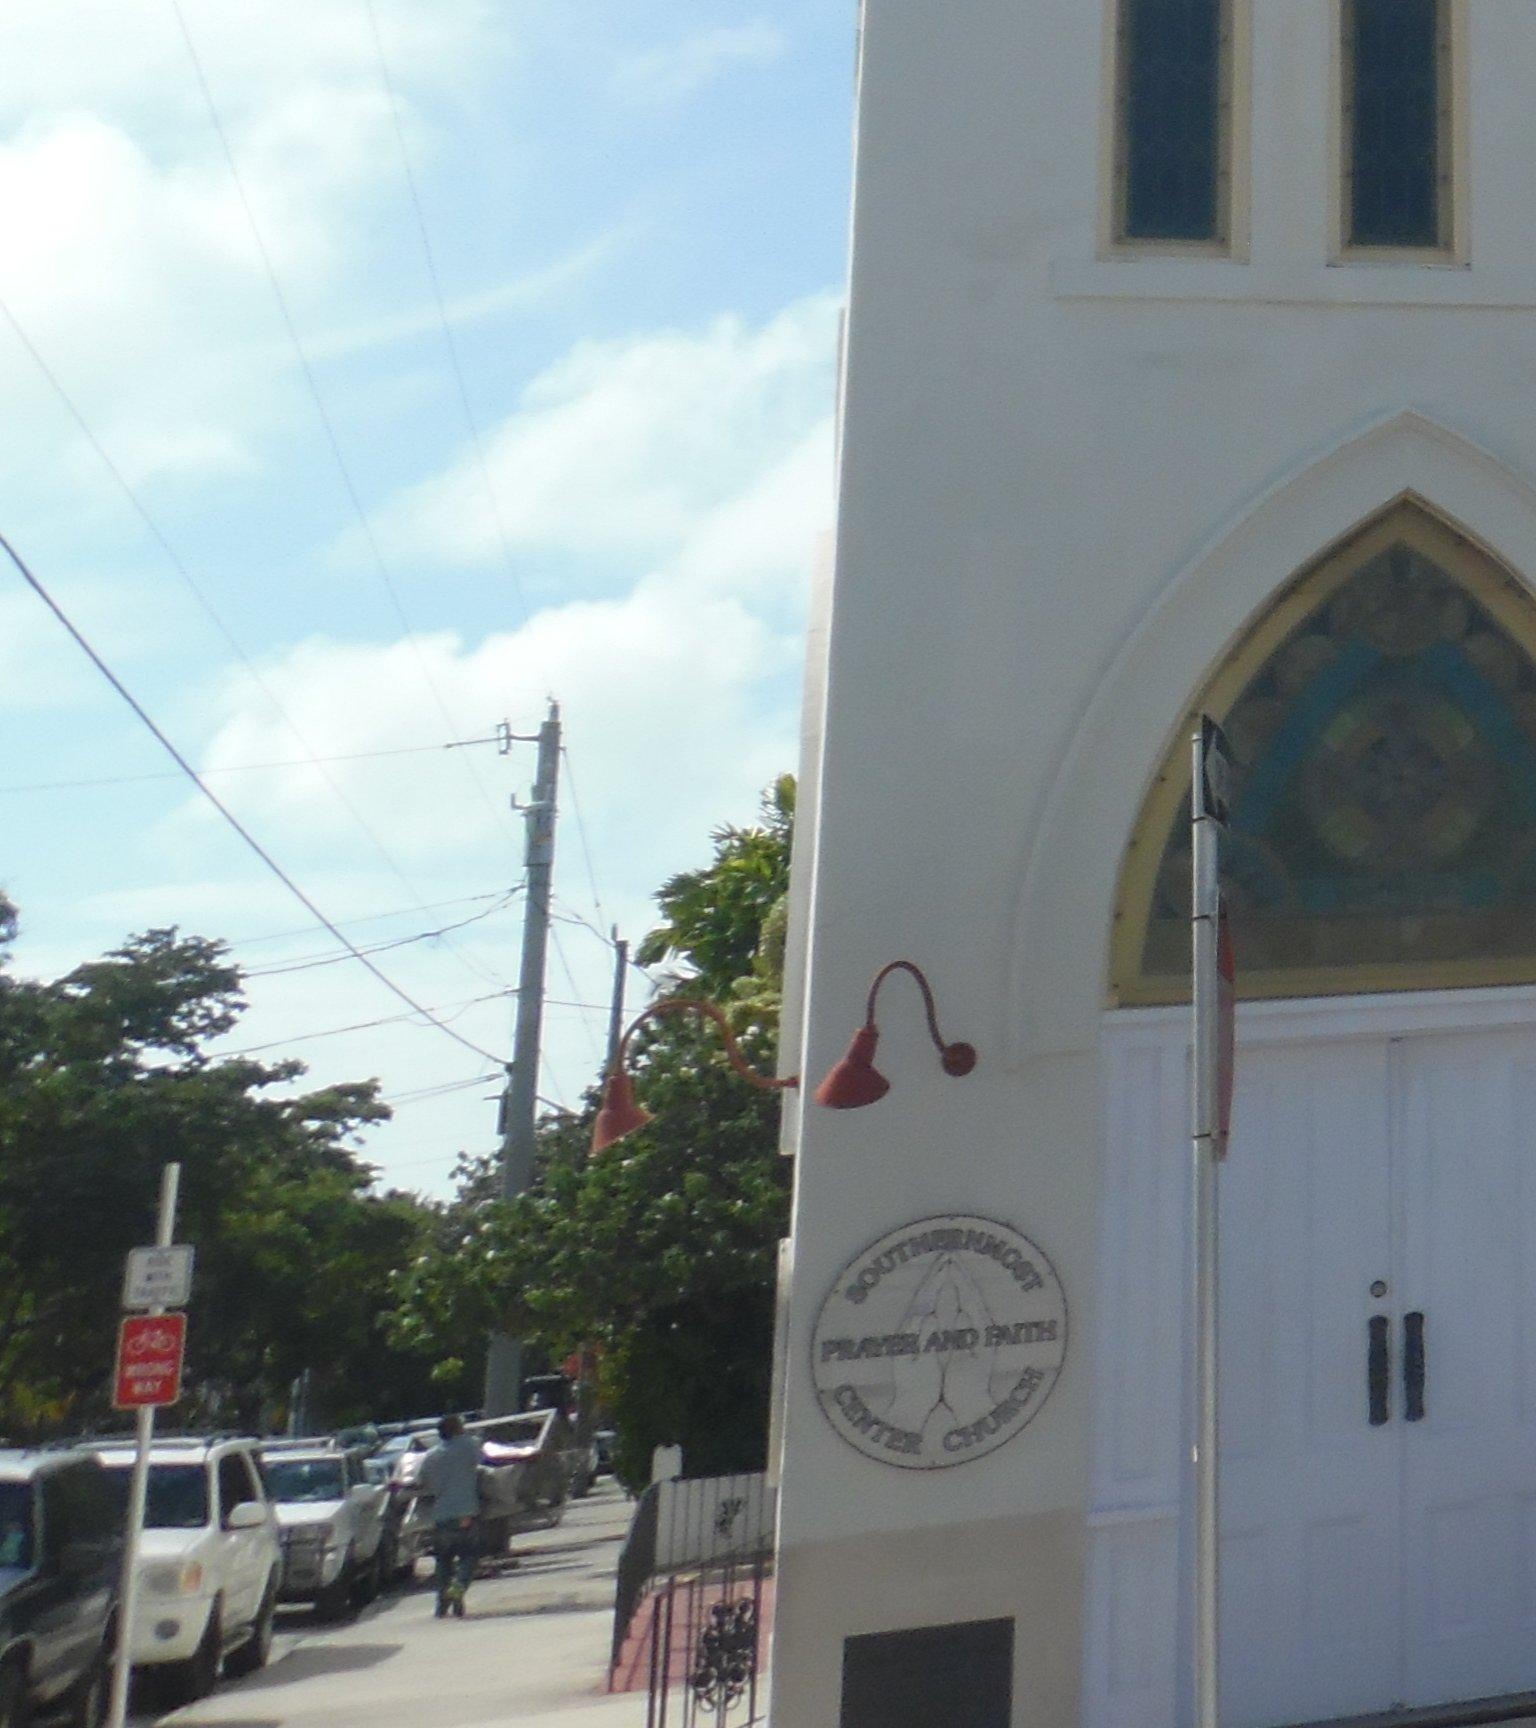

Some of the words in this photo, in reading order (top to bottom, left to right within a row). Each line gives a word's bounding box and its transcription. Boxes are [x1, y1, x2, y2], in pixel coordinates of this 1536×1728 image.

[845, 1228, 1043, 1304] SOUTHERNMOST
[820, 1332, 920, 1362] PRAYER
[923, 1327, 979, 1353] AND
[984, 1320, 1057, 1348] FAITH
[834, 1384, 923, 1454] CENTER
[942, 1367, 1044, 1452] CHURCH
